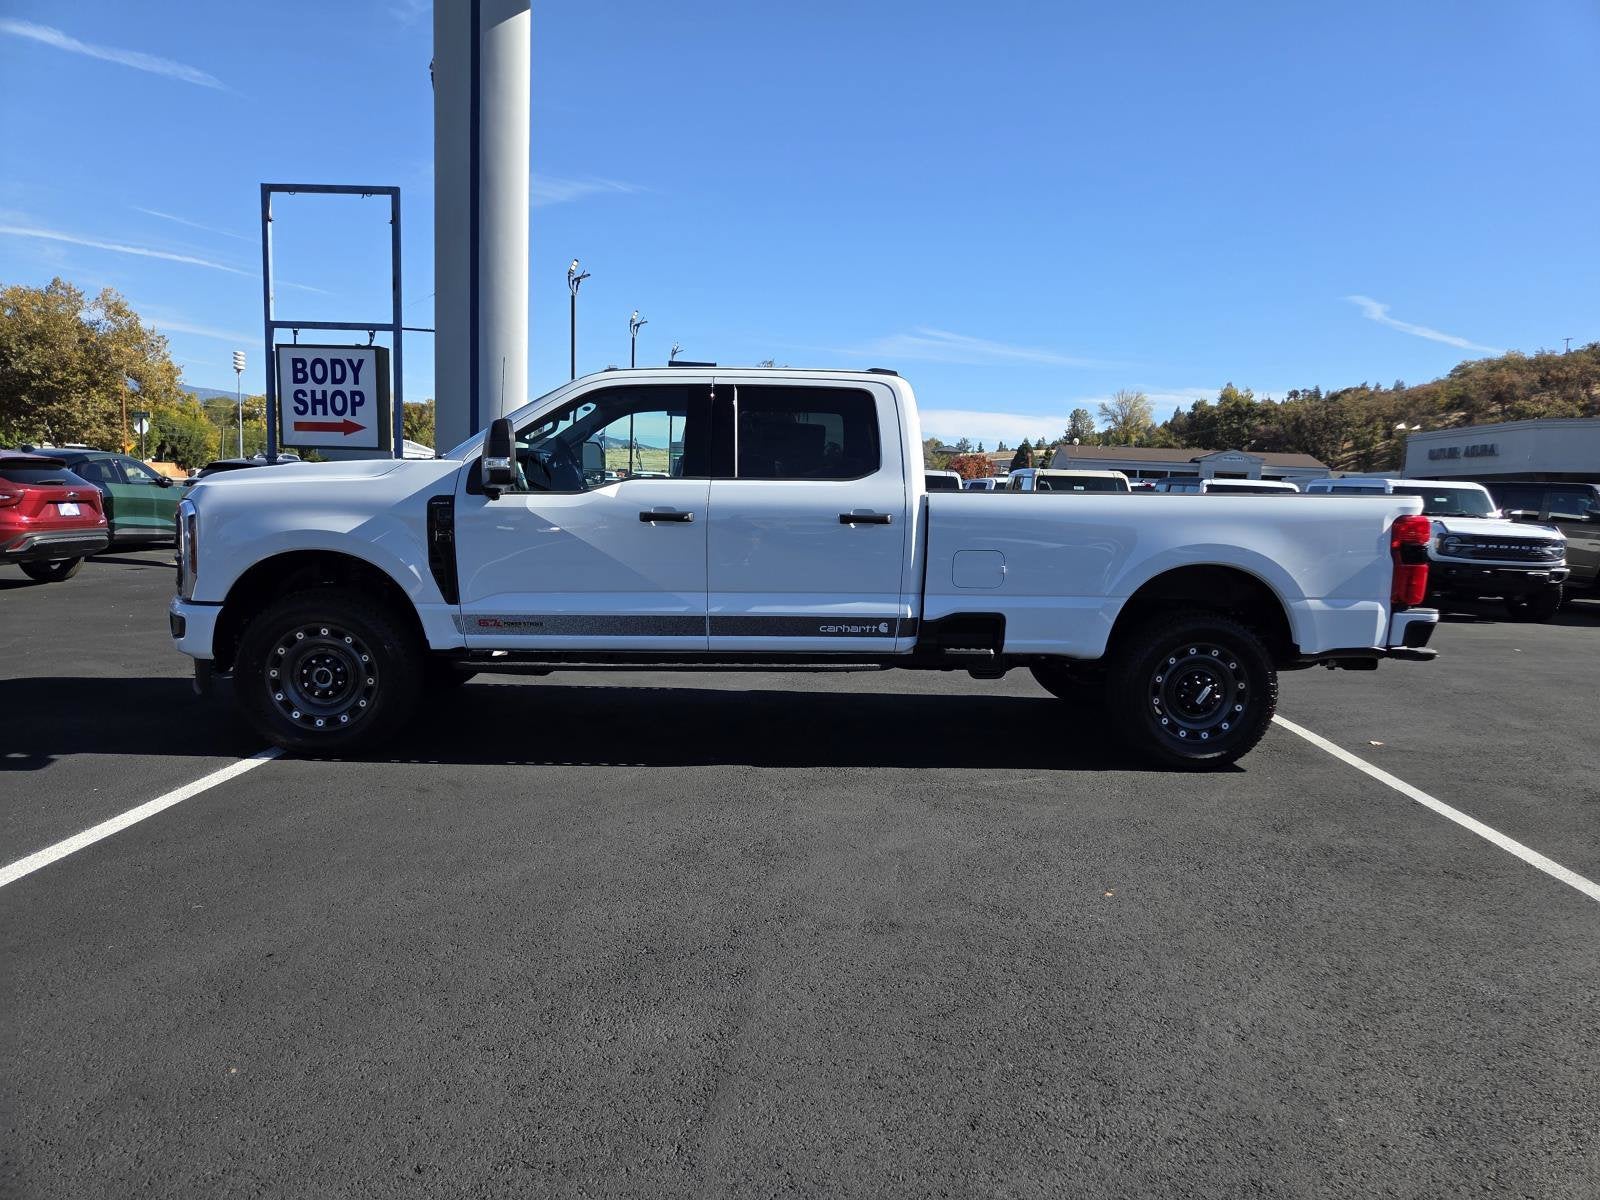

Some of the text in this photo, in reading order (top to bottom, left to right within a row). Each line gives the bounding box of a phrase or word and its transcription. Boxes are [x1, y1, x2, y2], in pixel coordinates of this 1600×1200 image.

[291, 357, 365, 385] BODY
[293, 388, 366, 417] SHOP
[819, 624, 878, 633] carhartt
